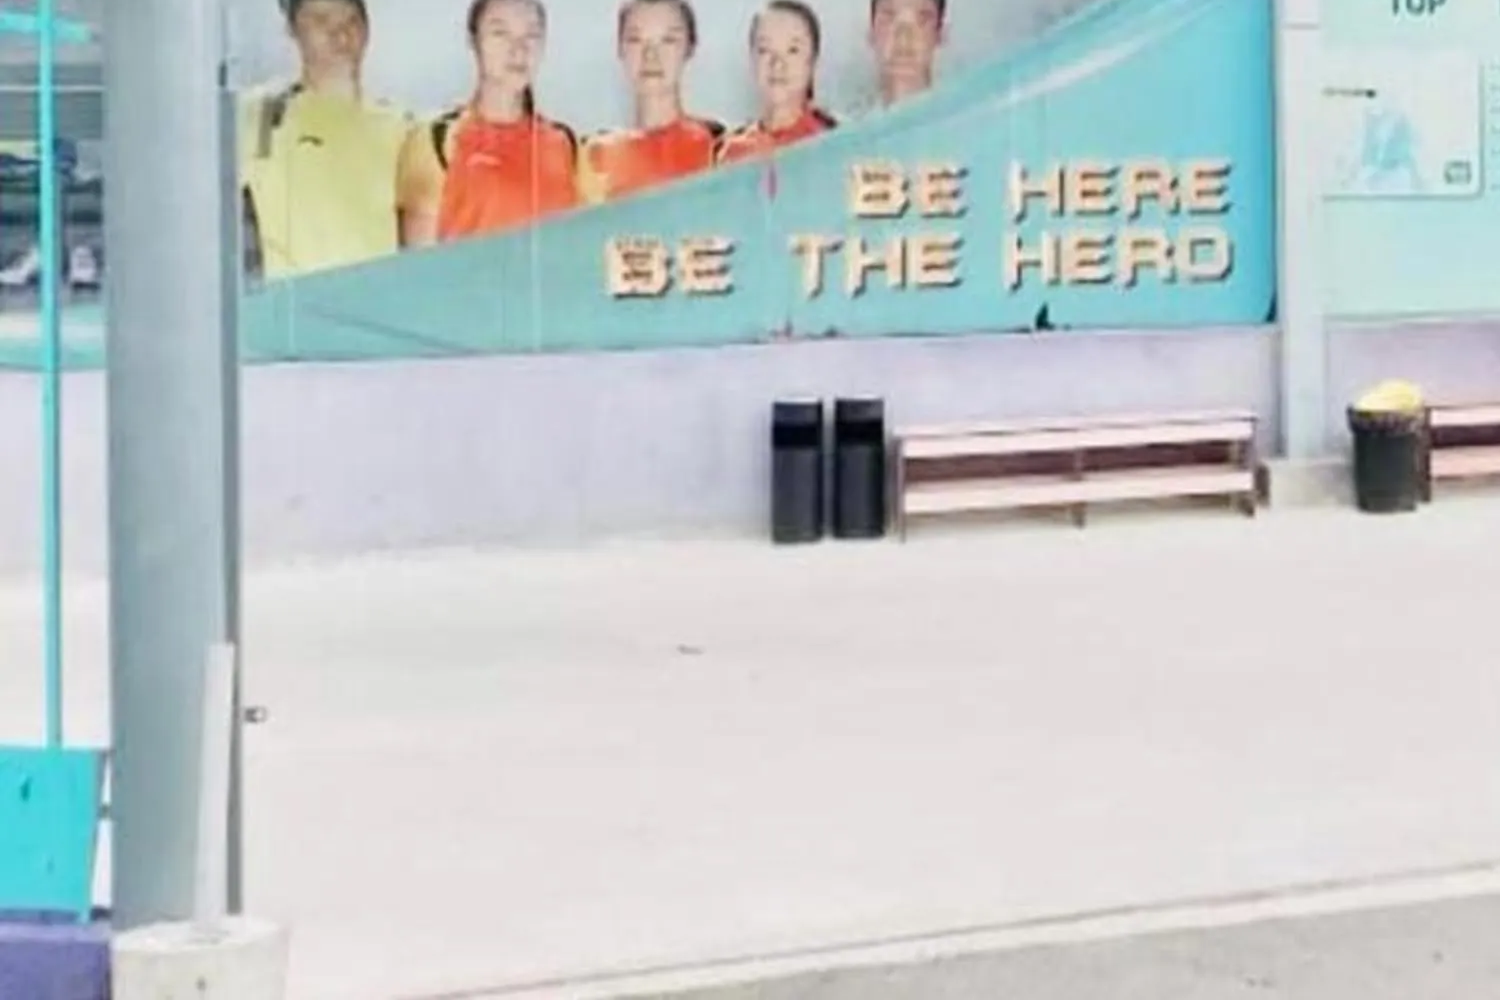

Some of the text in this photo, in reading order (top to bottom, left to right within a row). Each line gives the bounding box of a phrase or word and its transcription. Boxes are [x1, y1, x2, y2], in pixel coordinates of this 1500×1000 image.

[851, 160, 1232, 222] BE HERE
[605, 229, 1234, 300] BE THE HERO
